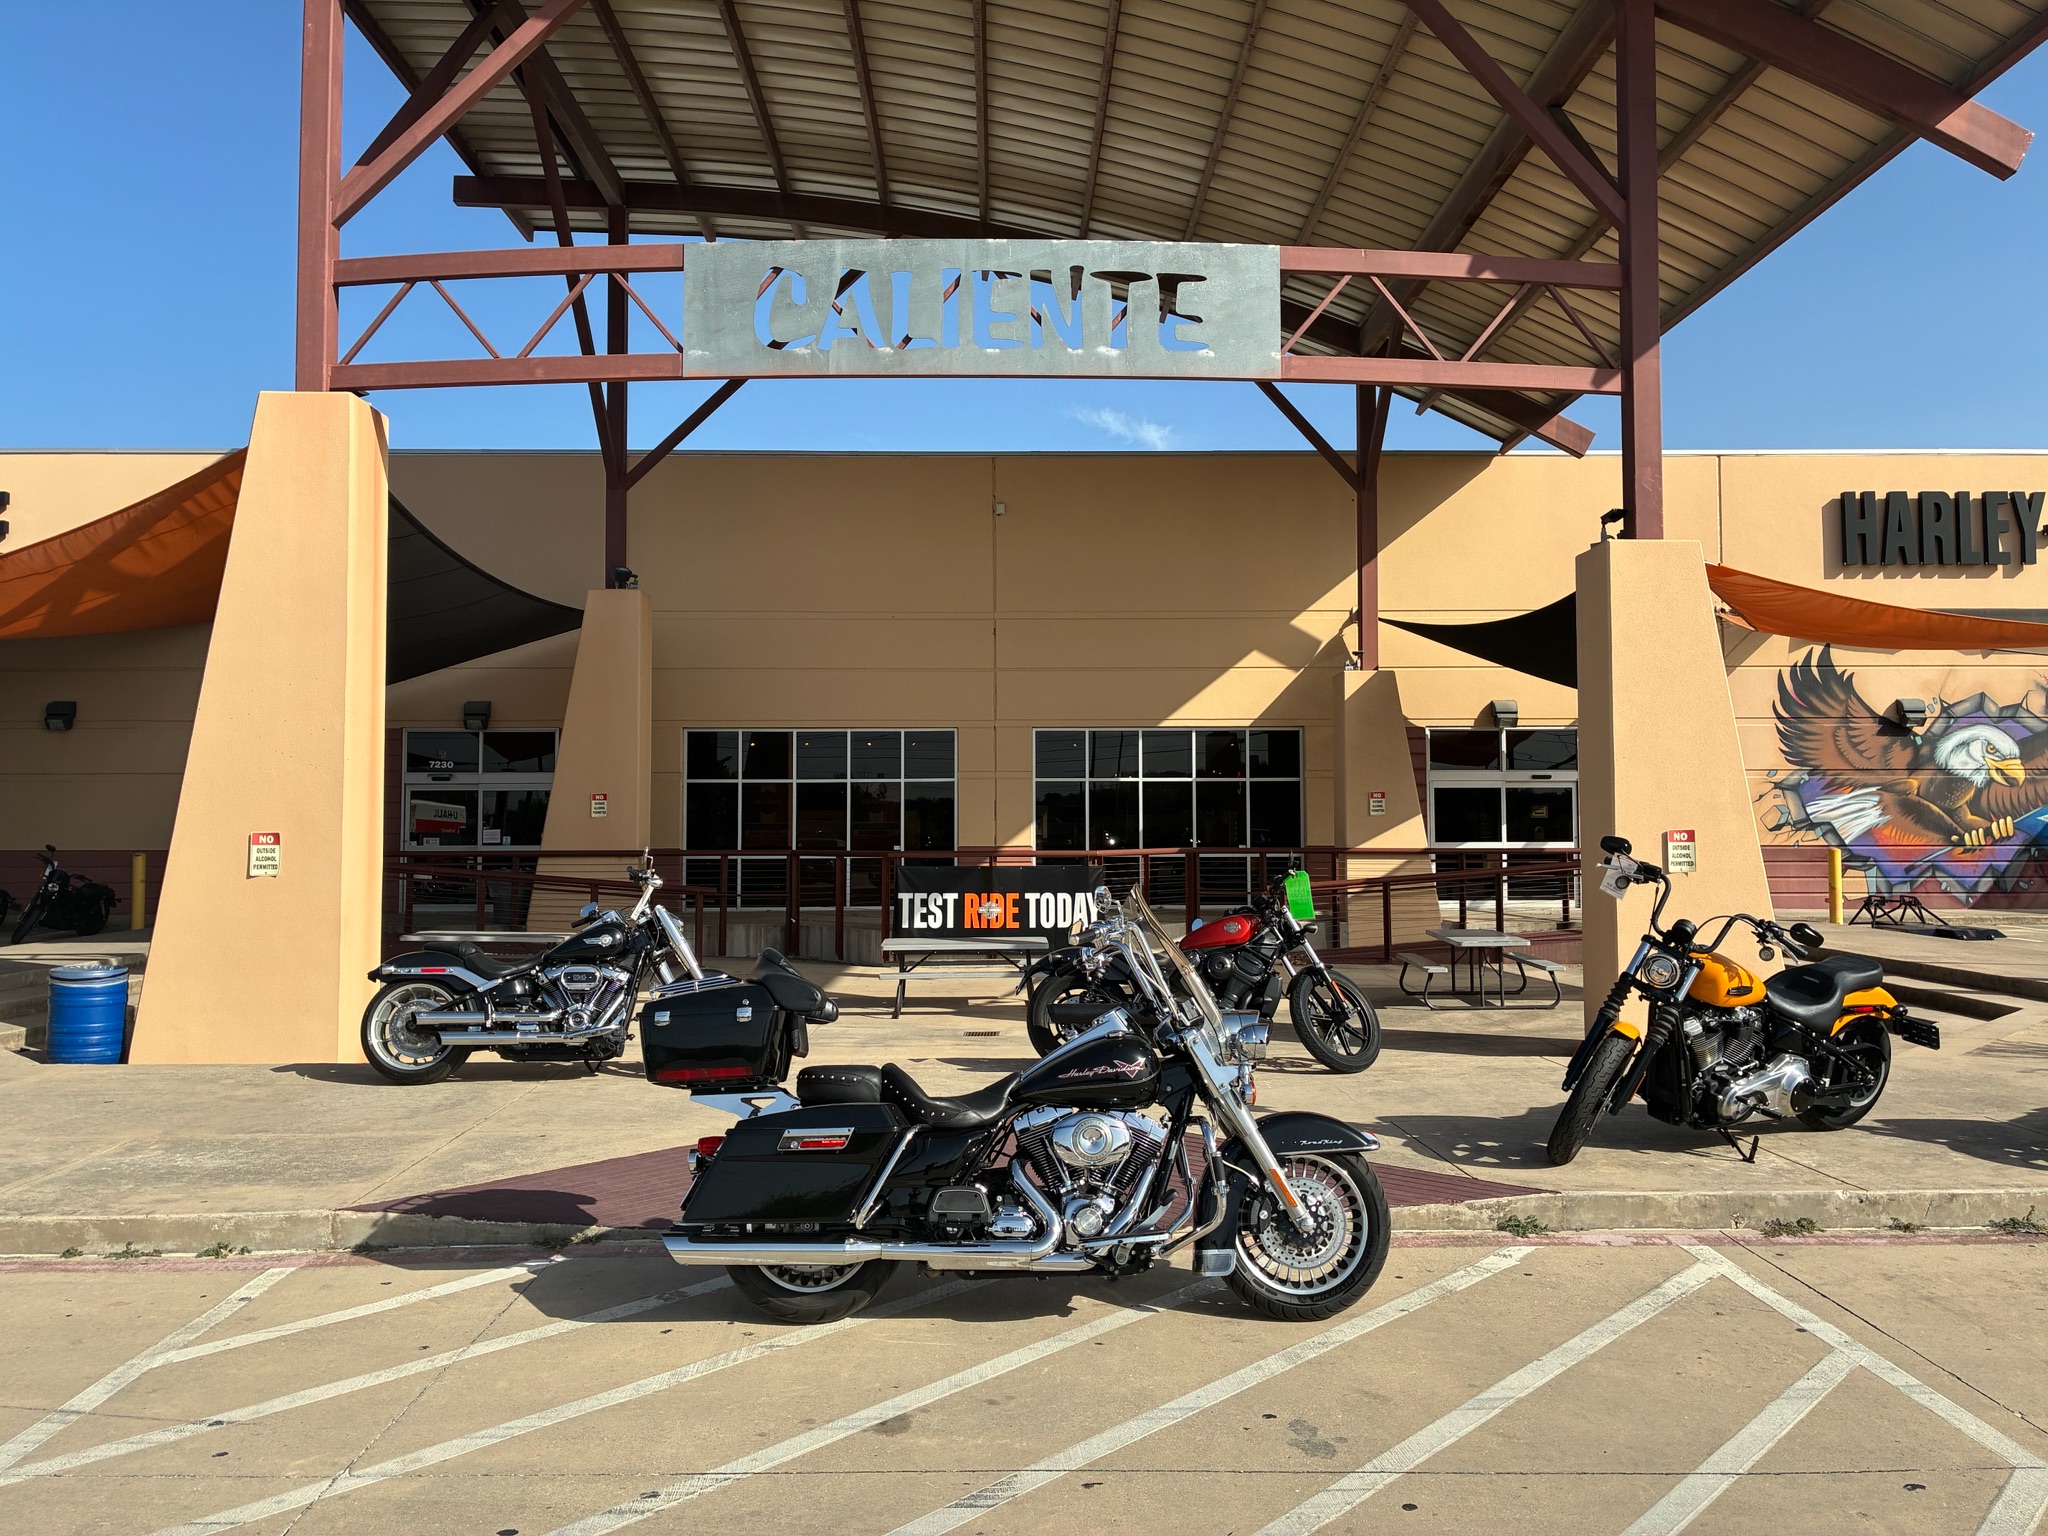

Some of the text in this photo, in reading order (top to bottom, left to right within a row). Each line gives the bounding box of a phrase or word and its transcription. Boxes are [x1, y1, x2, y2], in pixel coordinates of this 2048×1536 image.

[753, 266, 1210, 351] CALIENTE
[1840, 491, 2048, 565] HARLEY
[428, 760, 454, 769] 7230
[258, 835, 275, 844] NO
[1673, 831, 1688, 841] NO
[898, 892, 959, 929] TEST
[964, 892, 1020, 929] RIDE
[1025, 892, 1100, 929] TODAY
